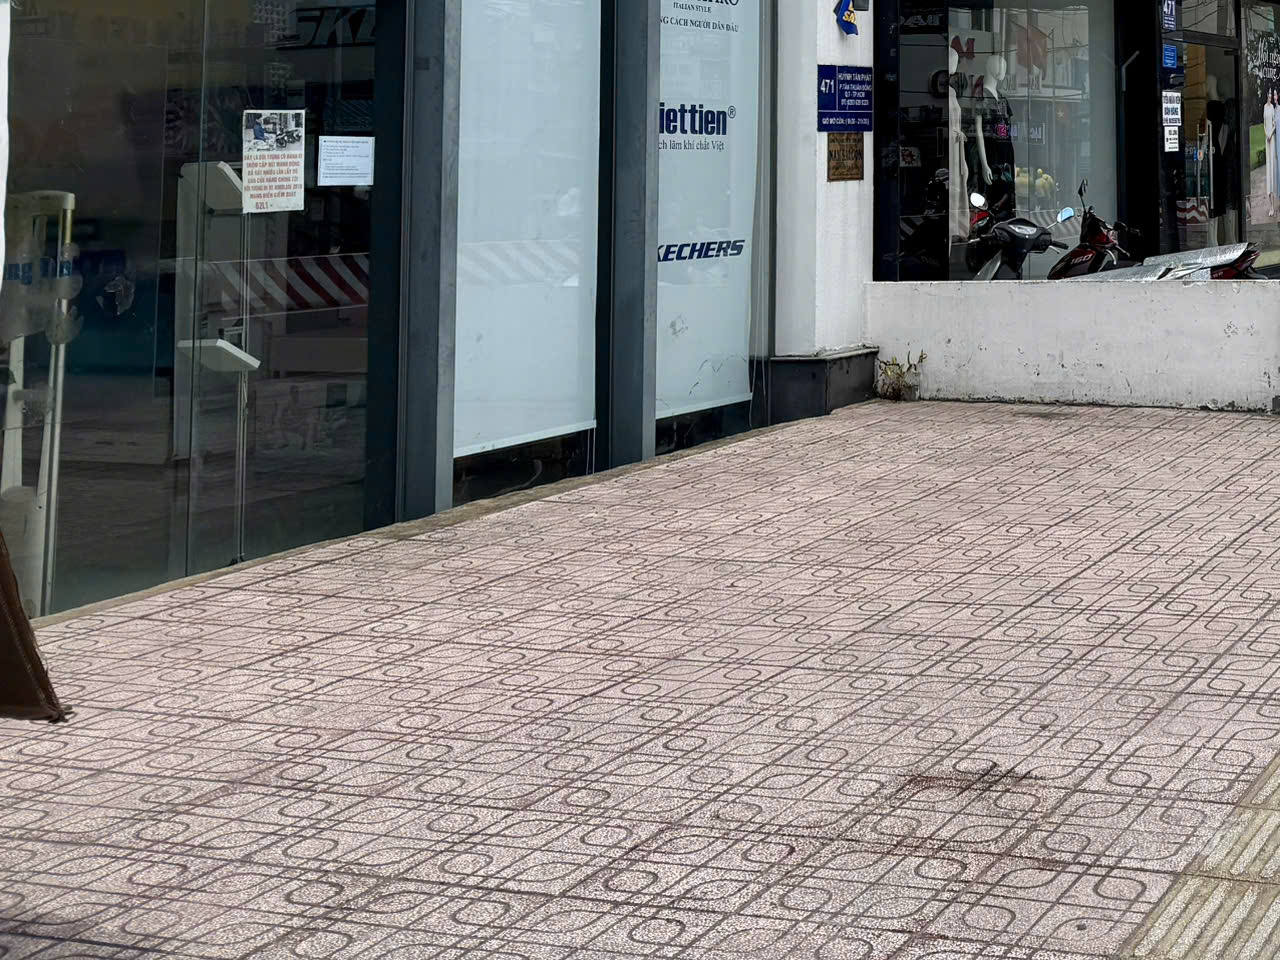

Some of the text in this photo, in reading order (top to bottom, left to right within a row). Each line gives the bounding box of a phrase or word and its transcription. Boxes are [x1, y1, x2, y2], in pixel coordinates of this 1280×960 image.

[1163, 0, 1175, 15] 471
[820, 78, 834, 94] 471
[683, 139, 695, 150] khí
[711, 139, 724, 152] Việt
